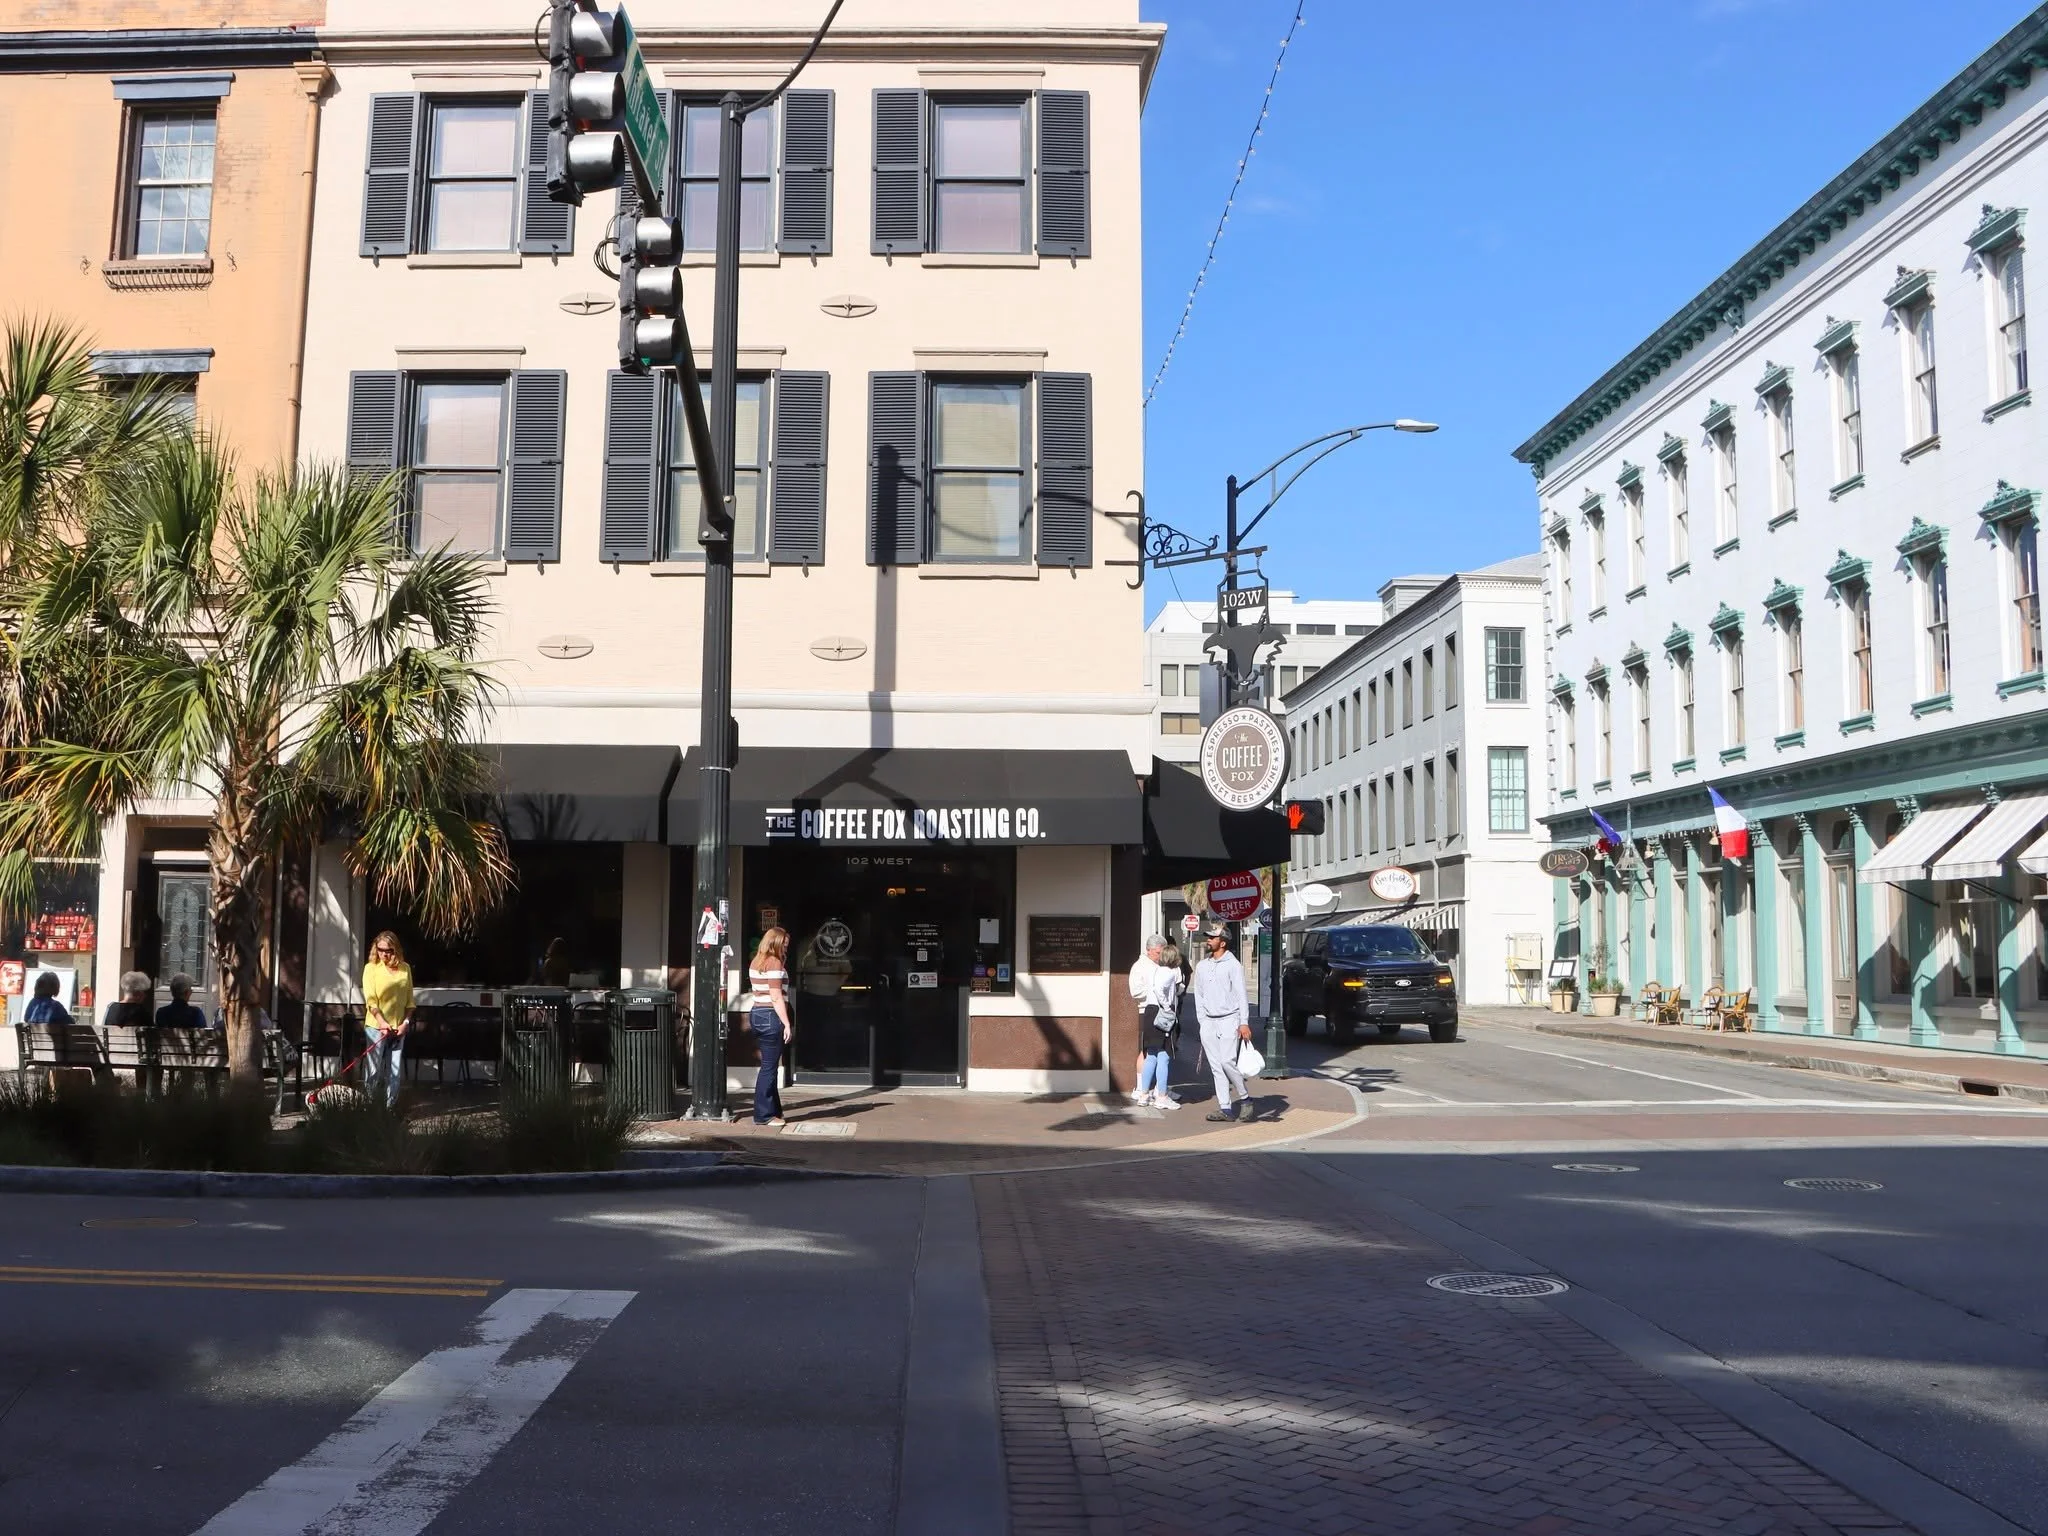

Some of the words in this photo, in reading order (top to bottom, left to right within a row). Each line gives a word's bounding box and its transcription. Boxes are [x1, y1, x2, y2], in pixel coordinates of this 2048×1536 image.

[1221, 590, 1263, 608] 102W
[1206, 714, 1240, 759] ESPRESSO
[1248, 713, 1280, 754] PASTRIES
[1222, 744, 1264, 769] COFFEE
[1207, 768, 1229, 798] CRAFT
[1230, 793, 1255, 803] BEER
[1231, 770, 1255, 782] FOX
[1260, 764, 1279, 791] WINE
[765, 815, 796, 829] THE
[801, 808, 867, 840] COFFEE
[872, 808, 906, 840] FOX
[913, 808, 1010, 840] ROASTING
[1016, 807, 1047, 838] CO.
[846, 857, 870, 865] 102
[873, 857, 913, 865] WEST
[1213, 878, 1228, 888] DO
[1231, 875, 1252, 886] NOT
[1220, 899, 1252, 912] ENTER
